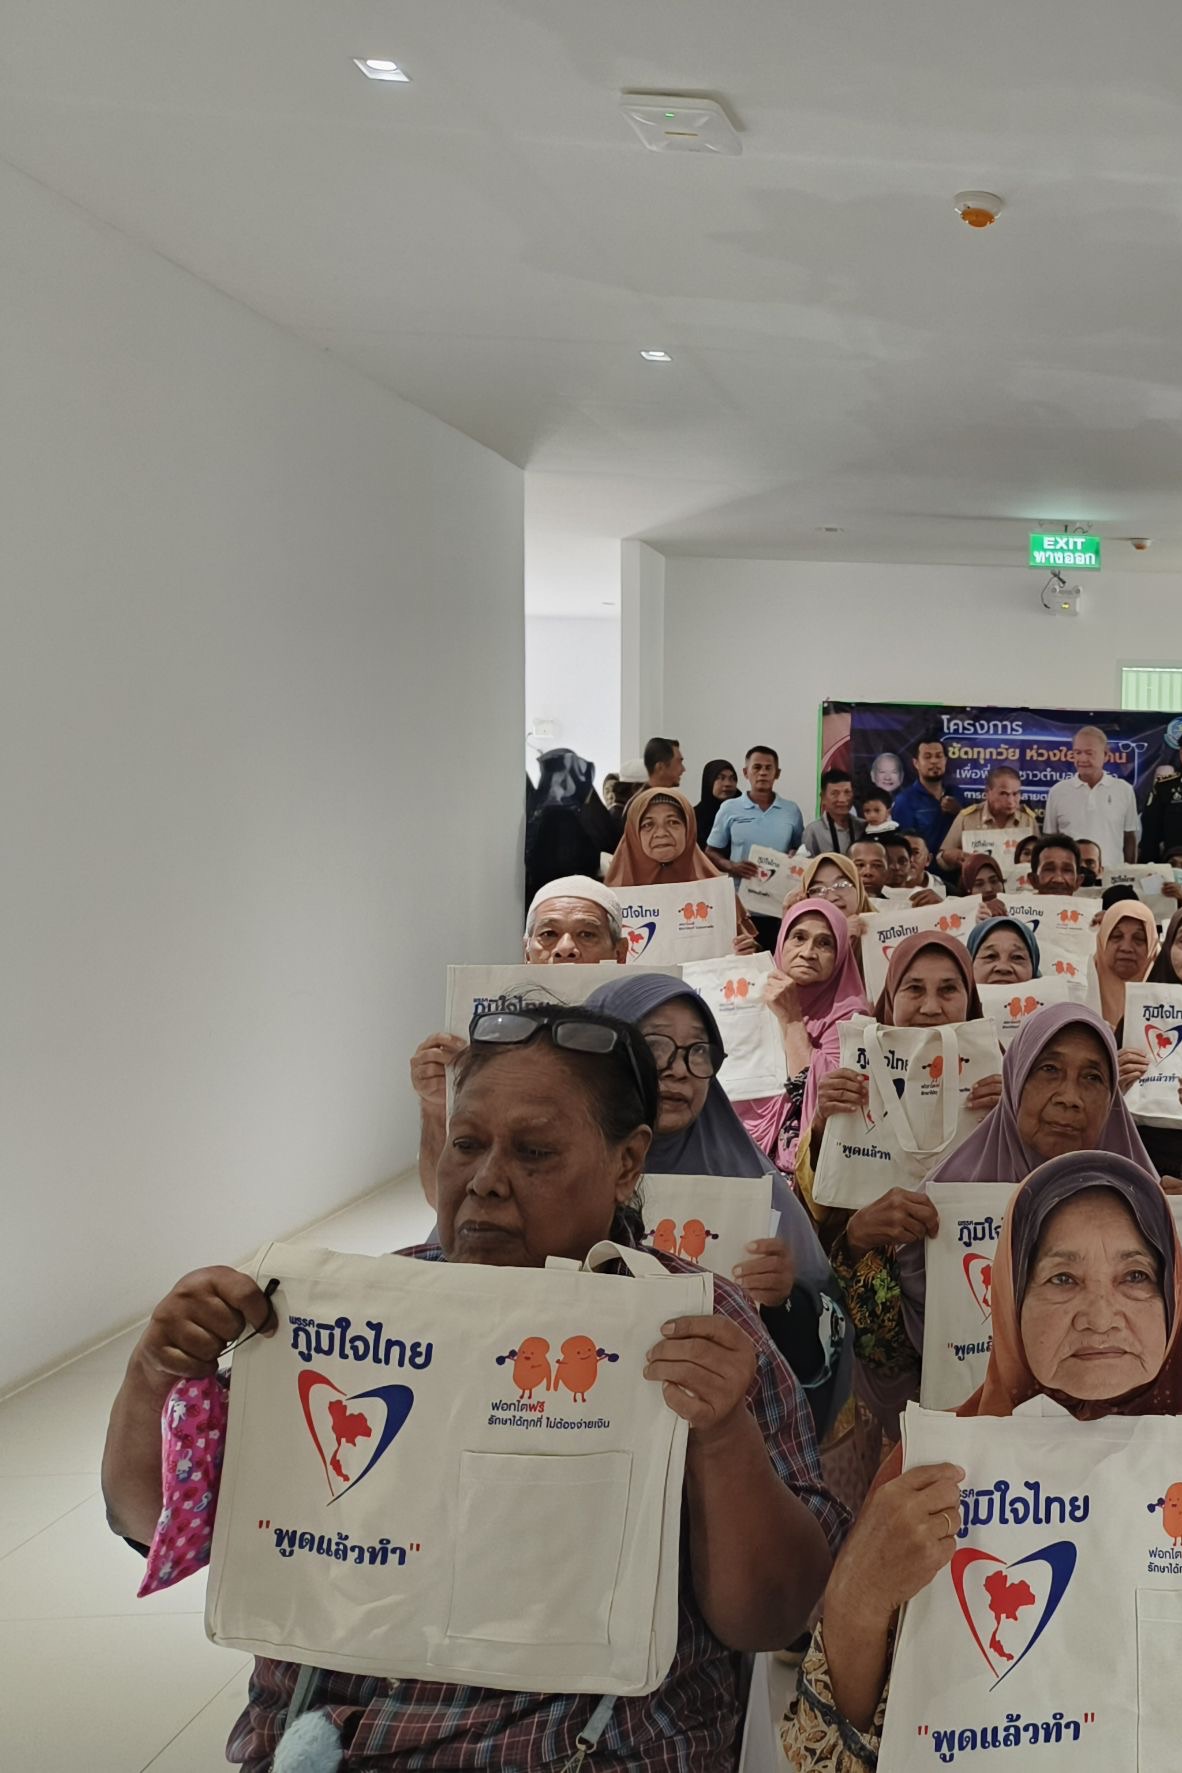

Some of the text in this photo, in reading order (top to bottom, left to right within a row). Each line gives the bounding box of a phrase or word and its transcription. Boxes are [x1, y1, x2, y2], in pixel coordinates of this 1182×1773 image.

[1043, 536, 1086, 550] EXIT
[1033, 550, 1097, 565] ทางออก
[940, 714, 1024, 736] โครงการ
[621, 905, 660, 919] มิใจไทย
[289, 1315, 315, 1328] พรรค
[290, 1316, 434, 1370] ภูมิใจไทย
[491, 1399, 546, 1414] ฟอกไตฟรี
[487, 1414, 611, 1430] รักษาได้ทุกที่ ไม่ต้องจ่ายเงิน
